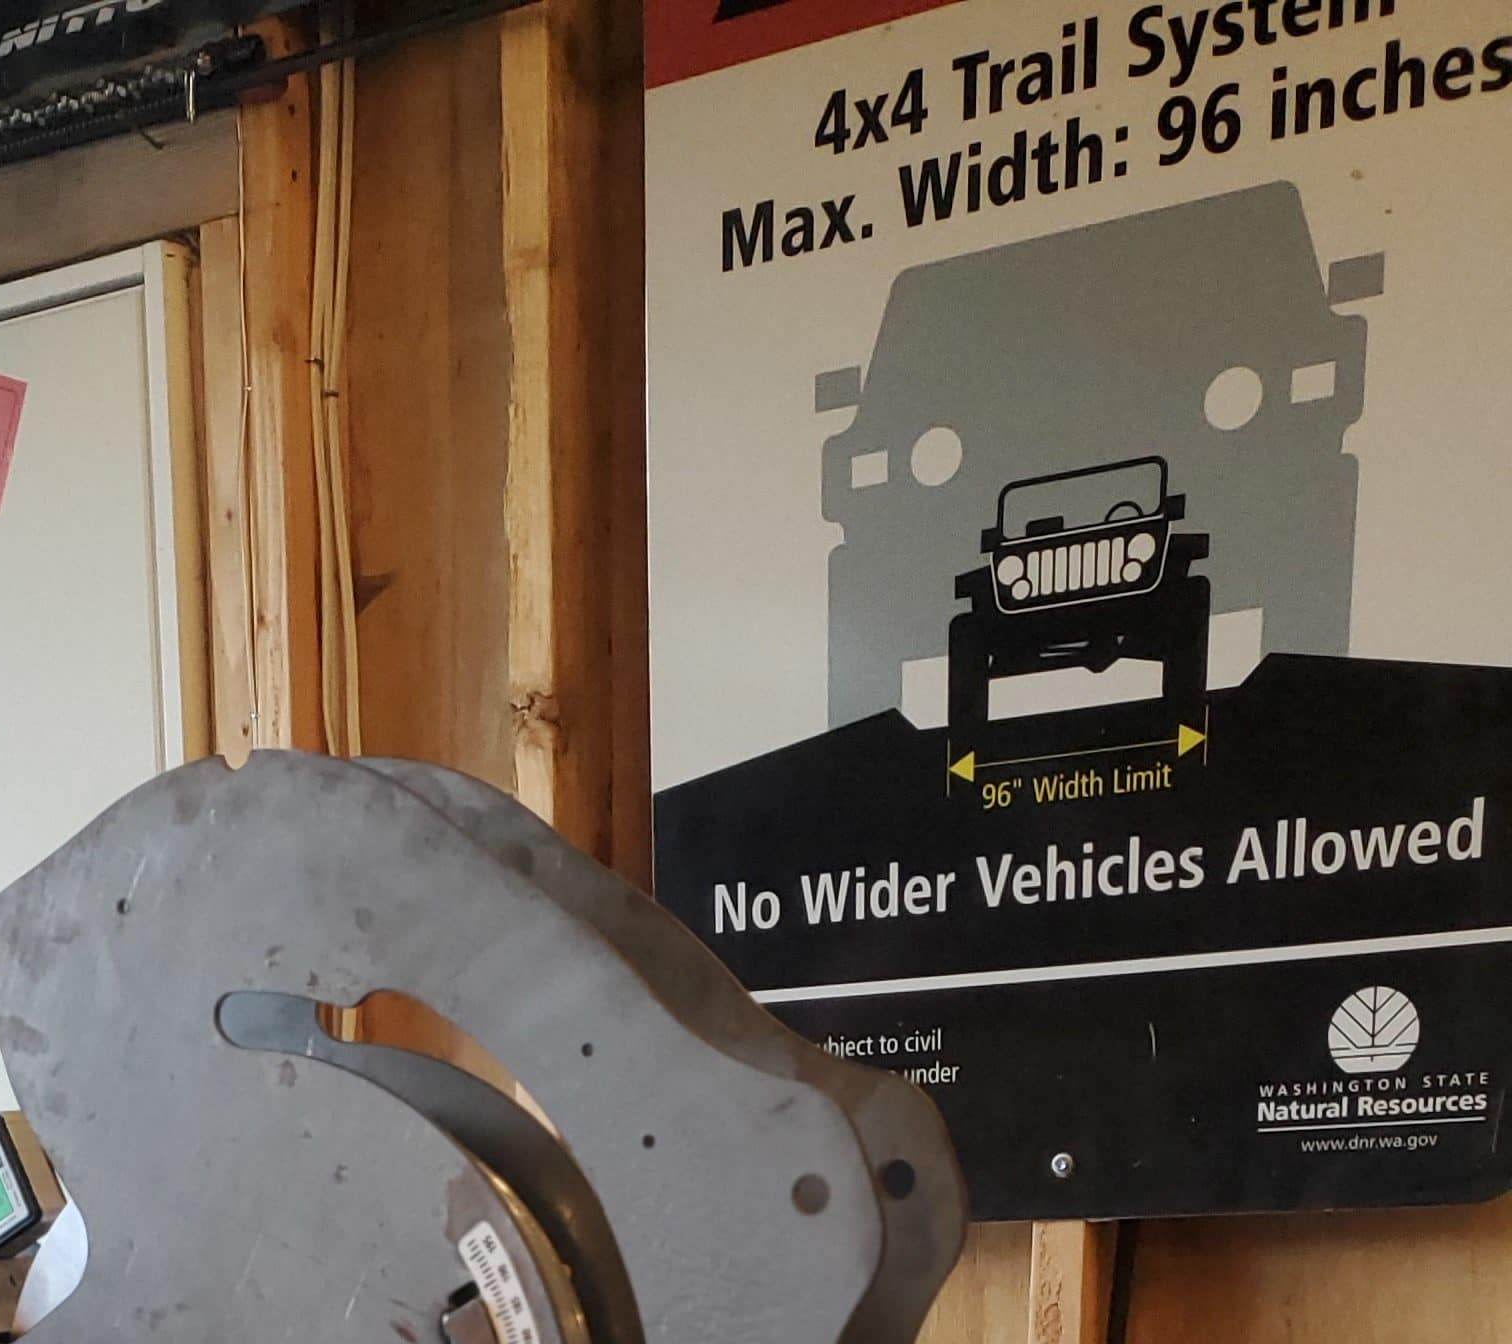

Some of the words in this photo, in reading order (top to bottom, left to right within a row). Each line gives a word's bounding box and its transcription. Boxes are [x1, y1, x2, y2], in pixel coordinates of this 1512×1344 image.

[814, 68, 928, 155] 4x4
[952, 16, 1098, 121] Trail
[721, 195, 873, 273] Max.
[898, 117, 1129, 228] Width:
[1157, 83, 1241, 167] 96
[1270, 34, 1512, 140] inches
[982, 778, 1022, 809] 96"
[1033, 769, 1104, 803] Width
[1113, 761, 1172, 794] Limit
[713, 881, 781, 934] No
[801, 862, 955, 925] Wider
[976, 835, 1205, 909] Vehicles
[1226, 796, 1486, 884] Allowed
[879, 1034, 899, 1054] to
[904, 1027, 942, 1053] civil
[904, 1060, 961, 1084] under
[1259, 1076, 1407, 1098] WASHINGTON
[1422, 1072, 1489, 1089] STATE
[1257, 1096, 1349, 1122] Natural
[1357, 1093, 1488, 1117] Resources
[1301, 1133, 1438, 1152] www.dnr.wa.gov
